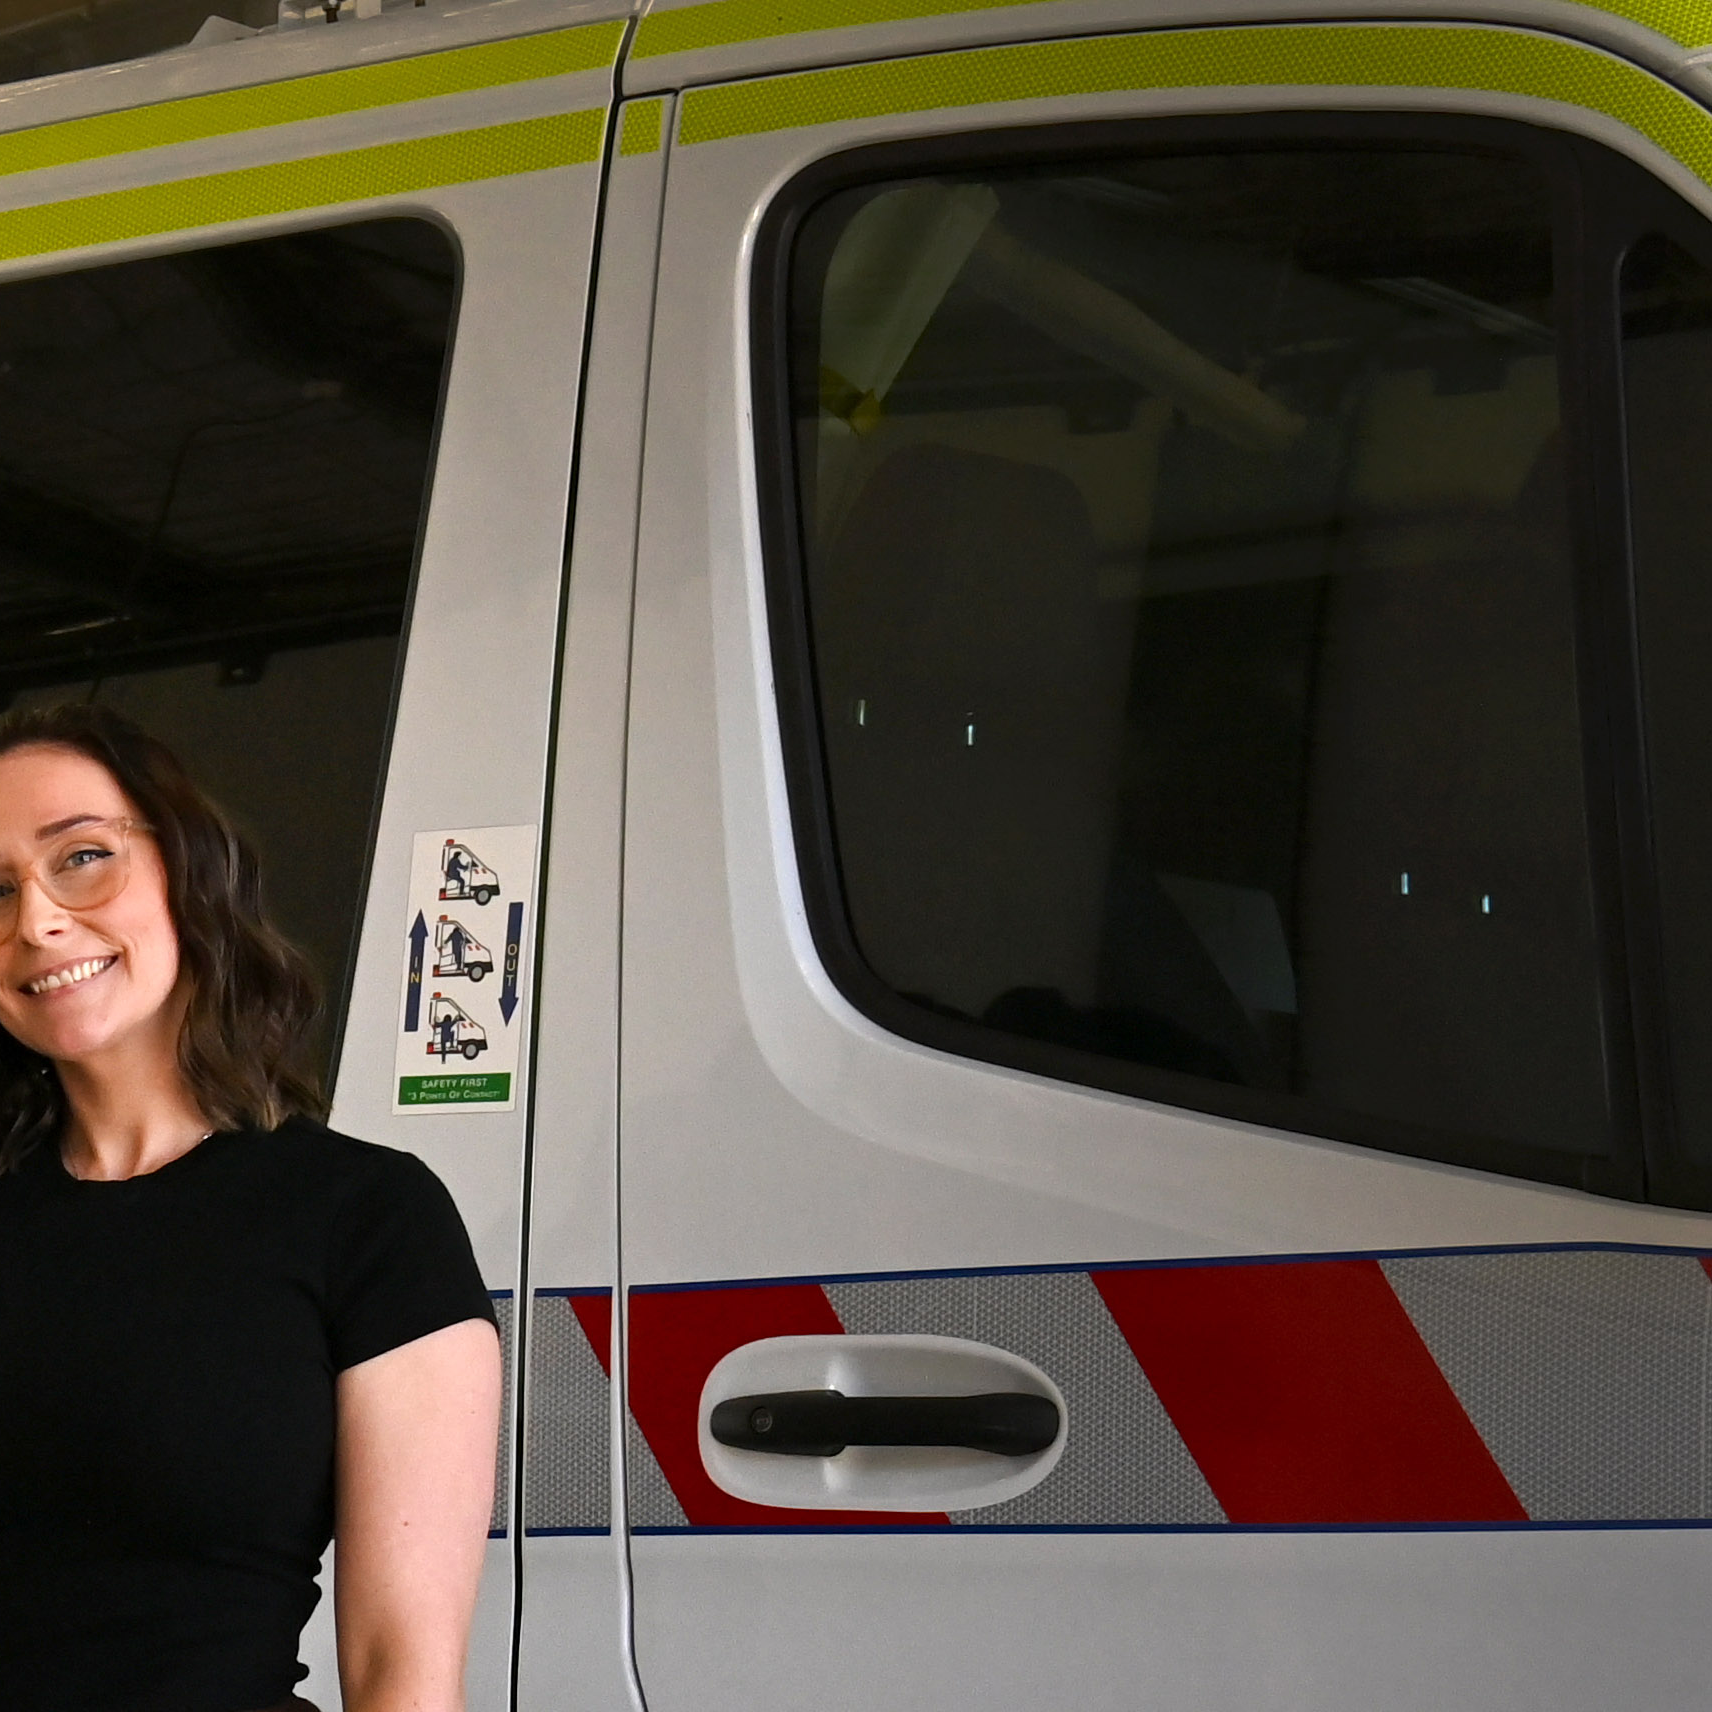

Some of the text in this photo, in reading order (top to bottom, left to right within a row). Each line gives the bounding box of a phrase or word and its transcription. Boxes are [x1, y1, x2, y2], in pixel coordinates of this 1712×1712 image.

[410, 956, 420, 983] IN
[506, 943, 518, 987] OUT
[421, 1078, 488, 1089] SAFETY FIRST
